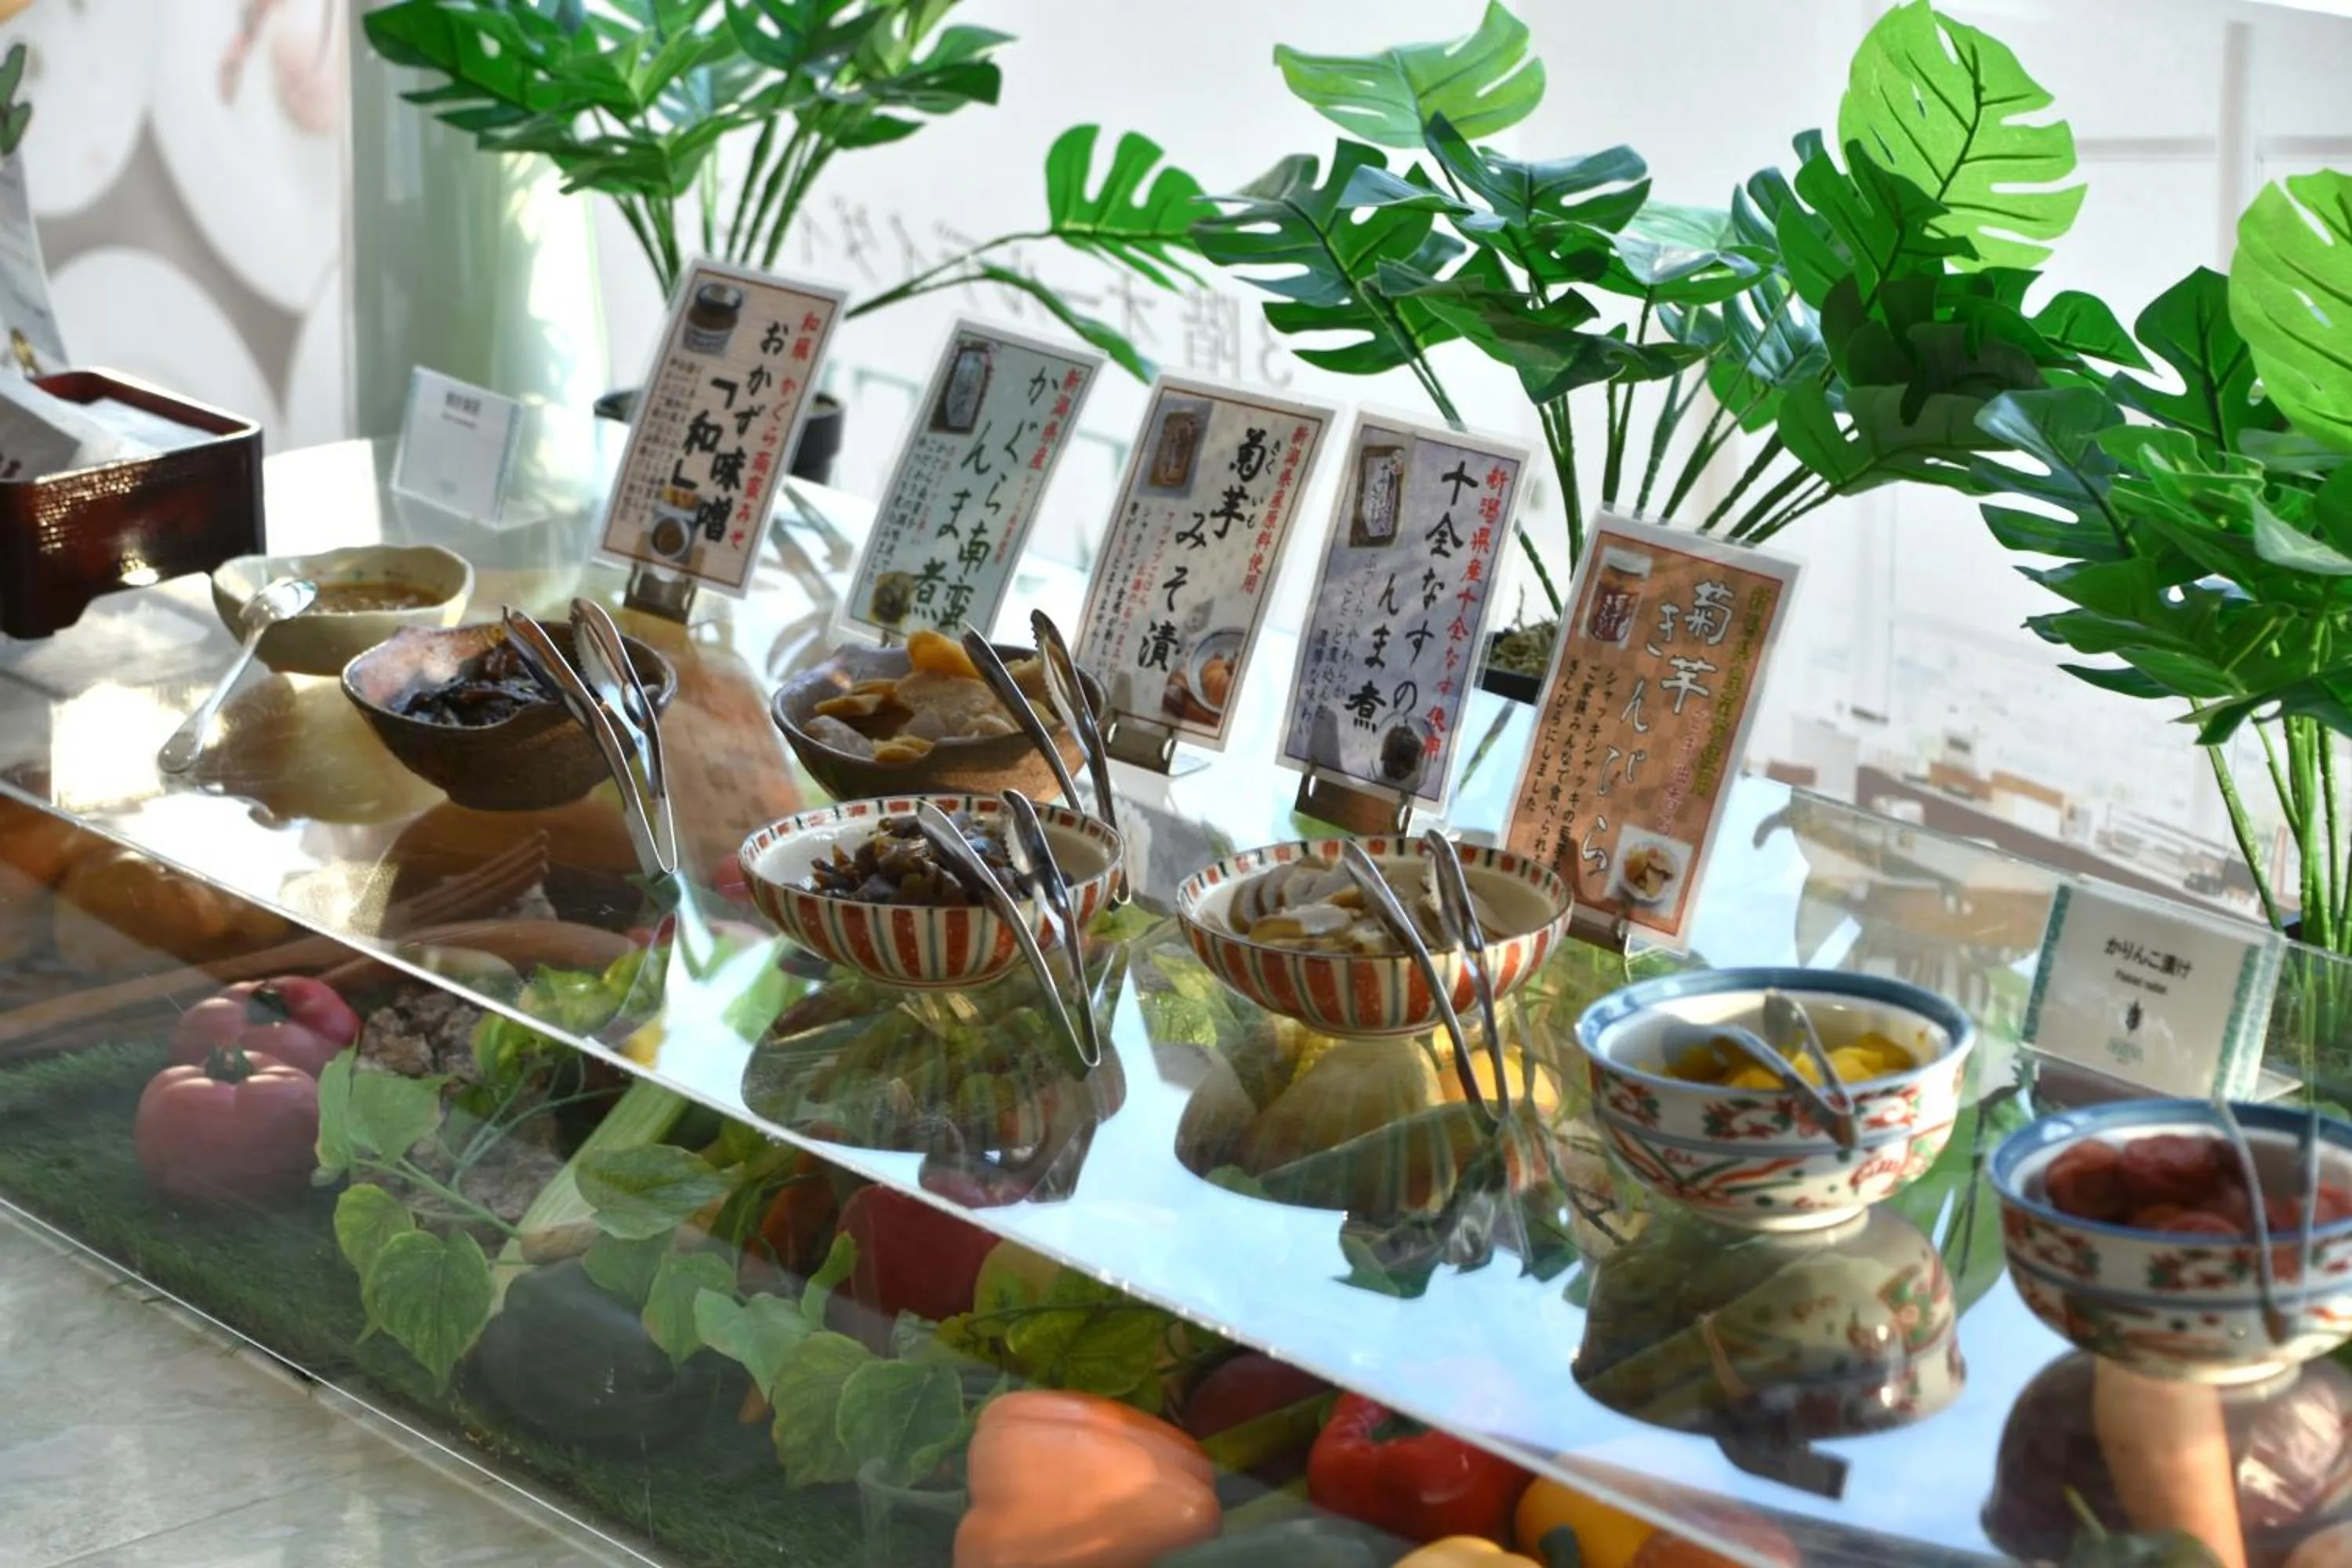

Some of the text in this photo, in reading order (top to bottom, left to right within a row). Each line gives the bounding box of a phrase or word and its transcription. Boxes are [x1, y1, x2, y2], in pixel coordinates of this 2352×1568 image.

[695, 321, 789, 543] おかず味噌
[938, 366, 1059, 629] かぐら南蛮
[1209, 426, 1267, 539] 菊芋
[1344, 572, 1401, 733] んま煮
[1392, 459, 1479, 717] 十全なすの
[1421, 466, 1510, 762] 新潟県産十全なす使用
[1660, 579, 1735, 714] 菊芋
[1581, 602, 1684, 878] きんぴら
